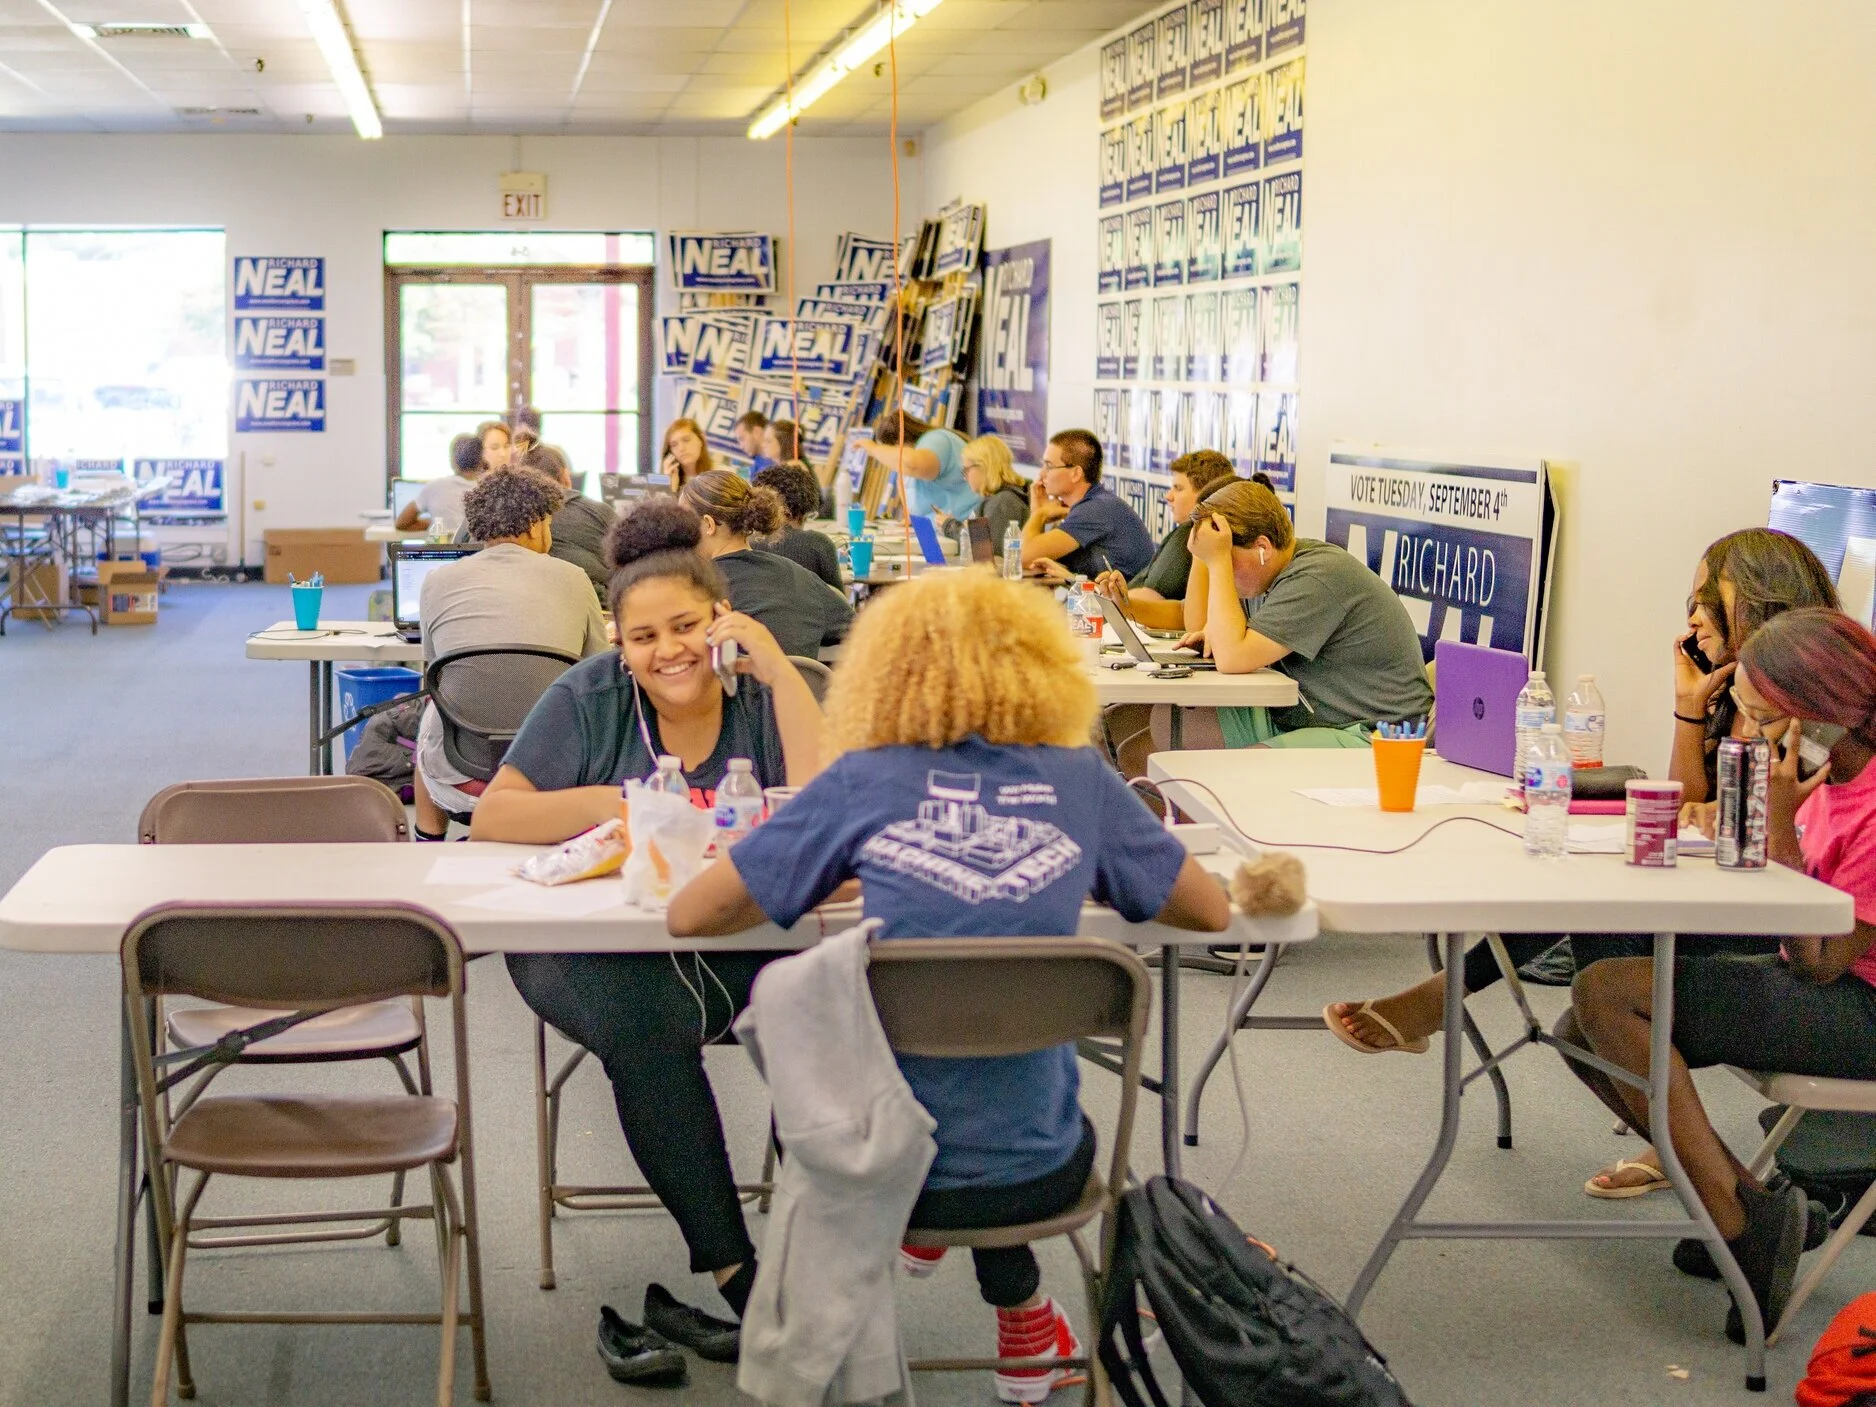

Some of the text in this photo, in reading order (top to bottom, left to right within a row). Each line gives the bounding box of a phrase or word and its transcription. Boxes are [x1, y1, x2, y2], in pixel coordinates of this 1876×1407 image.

[504, 194, 541, 217] EXIT
[268, 258, 318, 269] RICHARD
[683, 239, 769, 275] NEAL
[236, 259, 324, 296] NEAL
[236, 319, 324, 356] NEAL
[268, 318, 318, 329] RICHARD
[762, 321, 850, 359] NEAL
[978, 265, 1033, 391] NEAL
[237, 381, 324, 418] NEAL
[268, 380, 318, 391] RICHARD
[166, 460, 215, 470] RICHARD
[1350, 474, 1508, 521] VOTE TUESDAY, SEPTEMBER 4th
[1398, 534, 1496, 608] RICHARD
